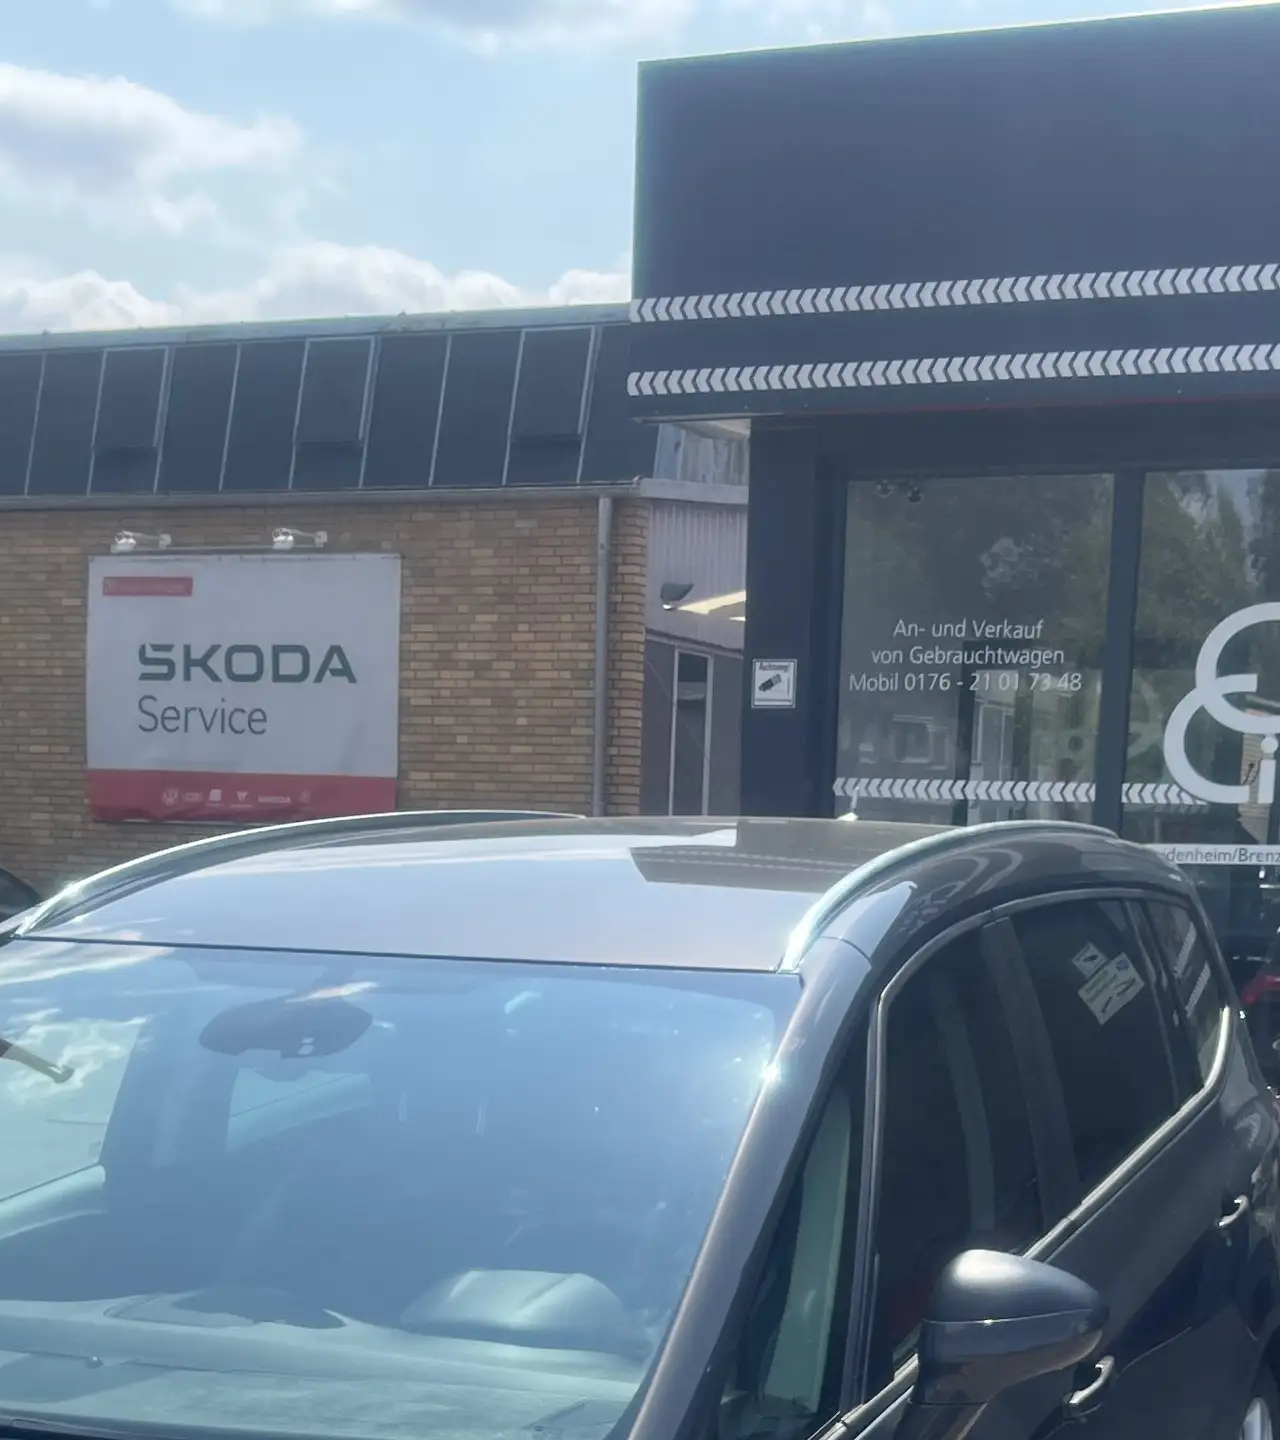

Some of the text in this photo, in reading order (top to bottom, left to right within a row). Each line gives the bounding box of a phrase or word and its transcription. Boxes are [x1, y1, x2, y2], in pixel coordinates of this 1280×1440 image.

[893, 617, 1044, 639] An- und Verkauf
[871, 646, 1065, 669] von Gebrauchtwagen
[849, 673, 898, 691] Mobil
[904, 673, 951, 690] 0176
[969, 673, 990, 690] 21
[998, 673, 1019, 691] 01
[1028, 673, 1051, 691] 73
[1056, 673, 1083, 691] 48
[138, 695, 268, 735] Service
